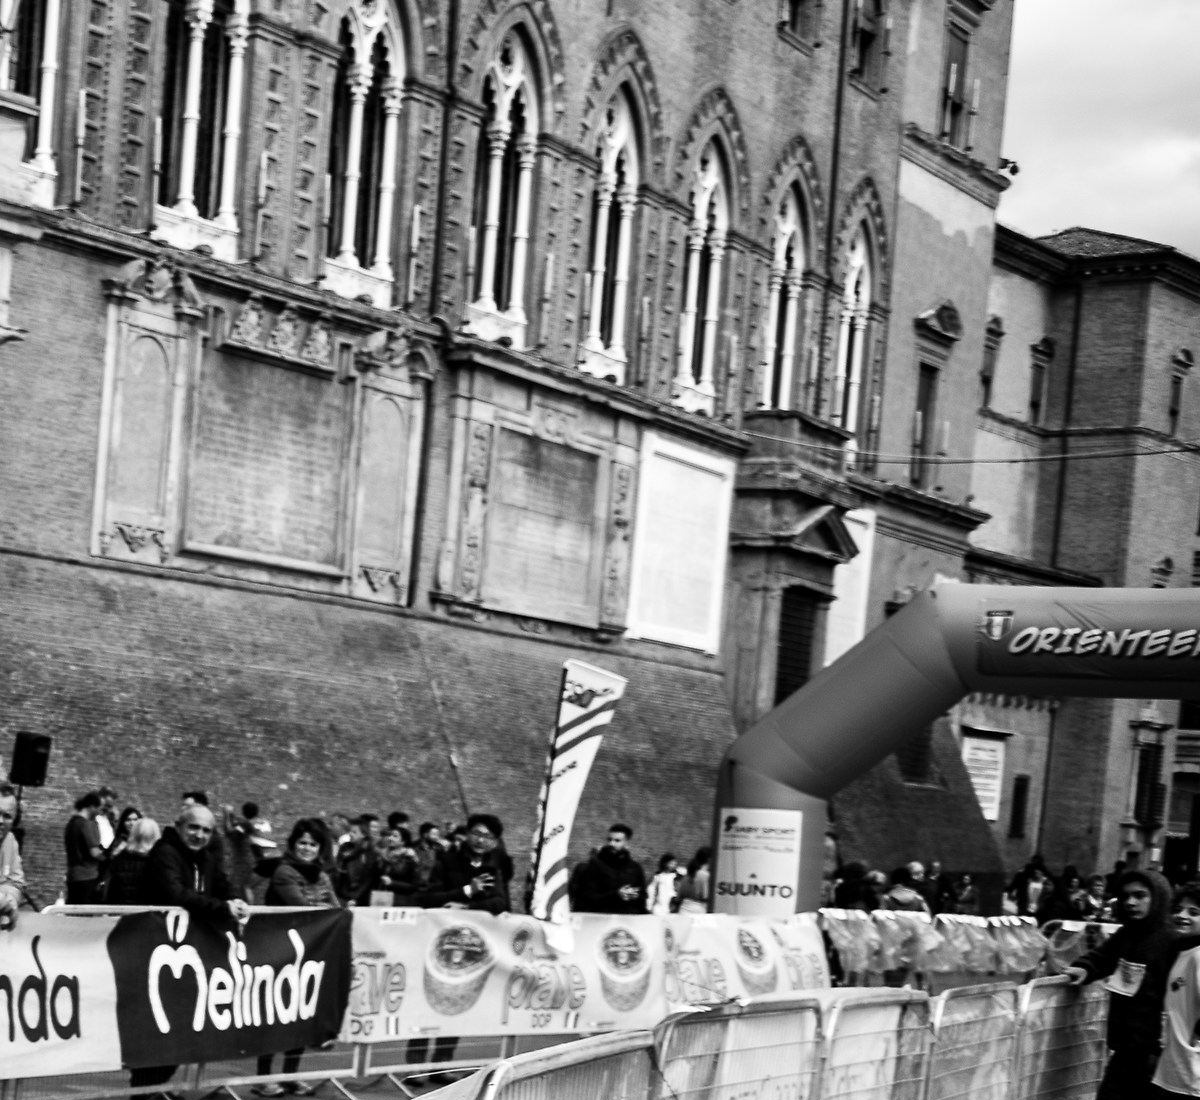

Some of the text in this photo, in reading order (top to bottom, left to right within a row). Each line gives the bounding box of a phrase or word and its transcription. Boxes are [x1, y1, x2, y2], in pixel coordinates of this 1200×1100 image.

[717, 881, 793, 898] SUUNTO
[148, 928, 325, 1034] Melinda
[350, 961, 406, 1016] ave
[501, 963, 587, 1025] piave
